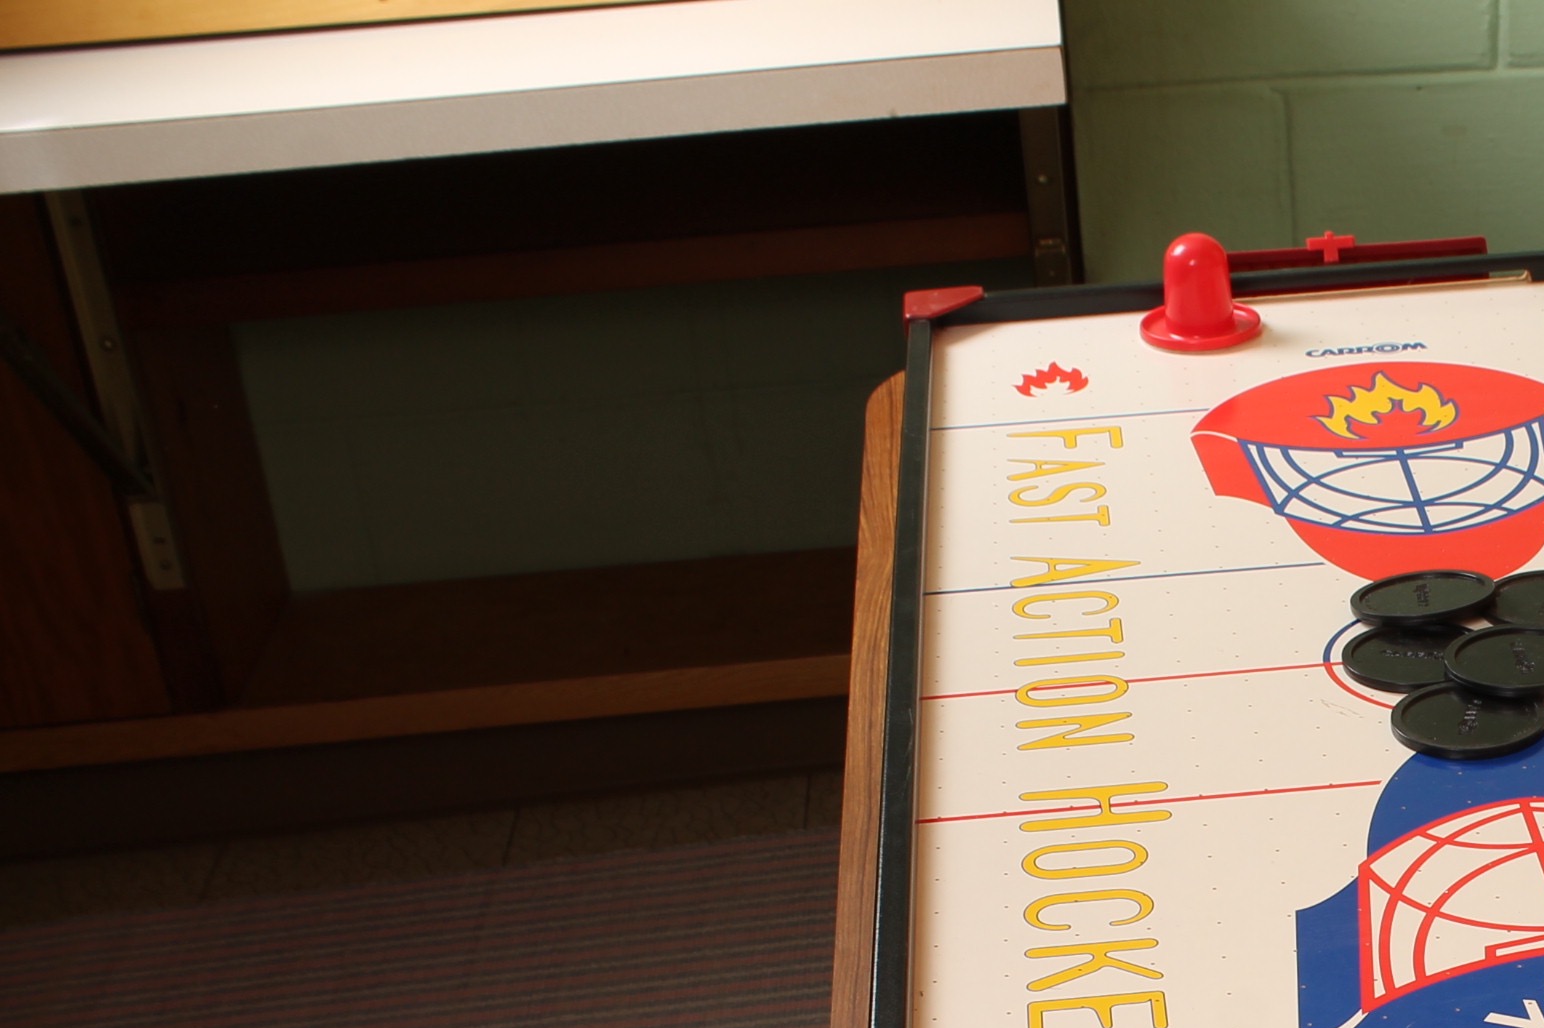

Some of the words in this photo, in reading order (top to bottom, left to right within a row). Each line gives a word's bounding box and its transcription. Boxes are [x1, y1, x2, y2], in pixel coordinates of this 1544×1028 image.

[1305, 341, 1427, 358] CARROM
[1006, 426, 1124, 527] FAST
[1010, 556, 1141, 750] ACTION
